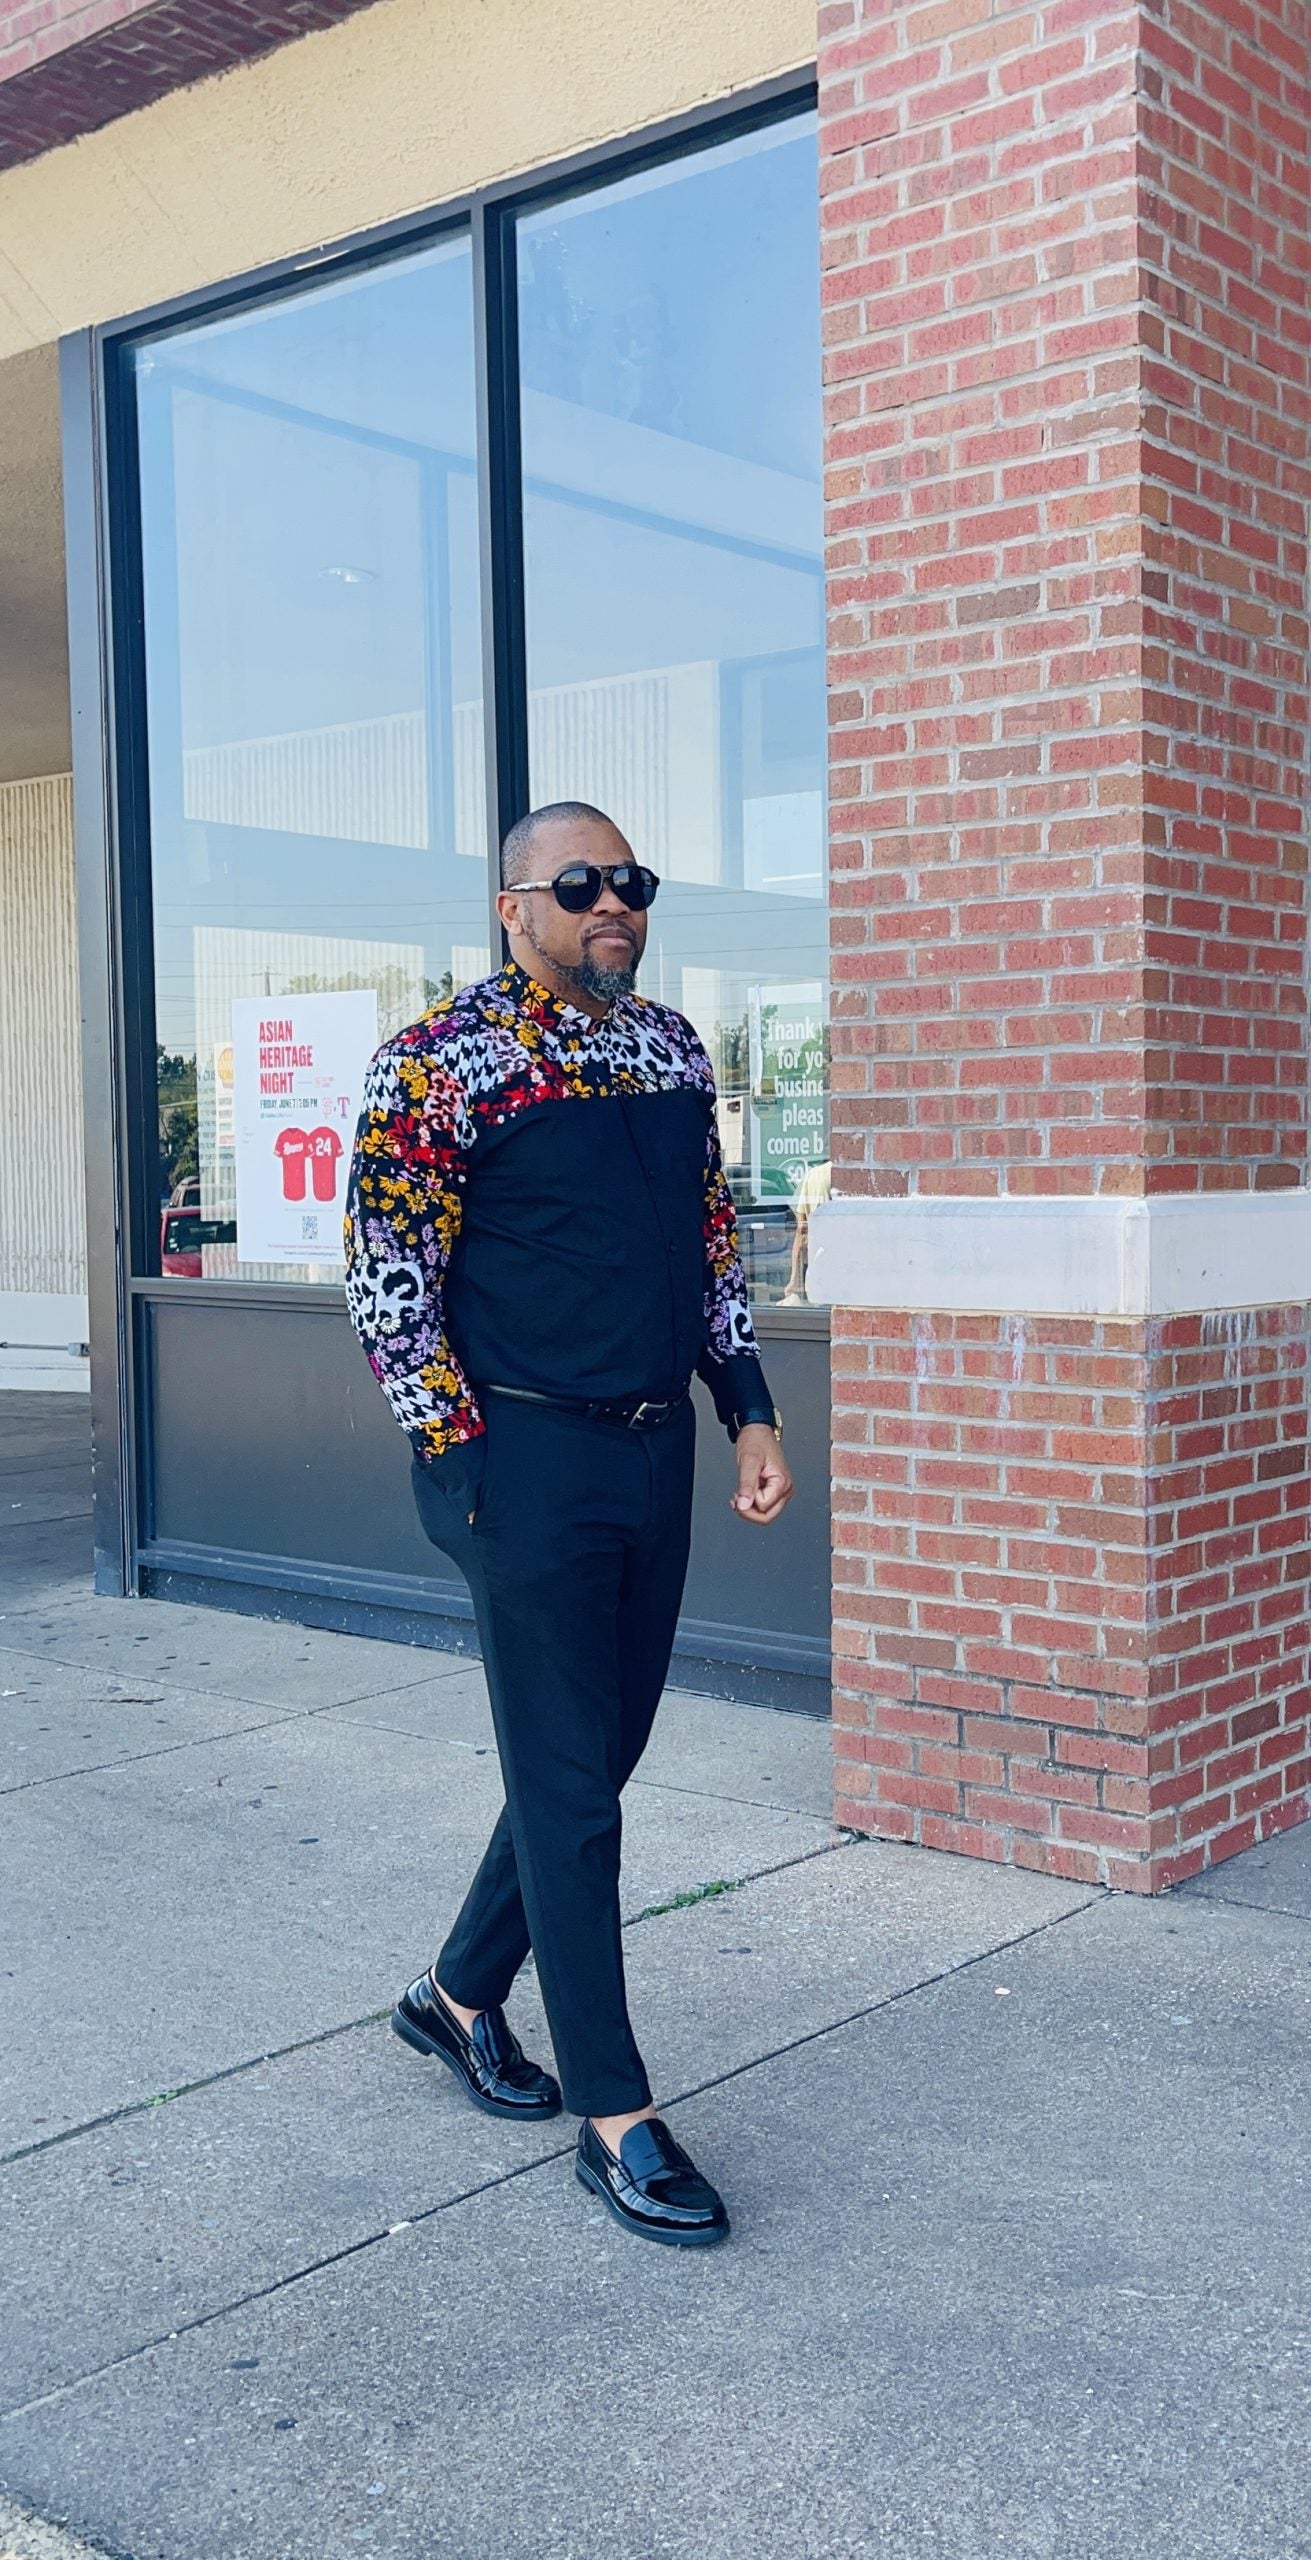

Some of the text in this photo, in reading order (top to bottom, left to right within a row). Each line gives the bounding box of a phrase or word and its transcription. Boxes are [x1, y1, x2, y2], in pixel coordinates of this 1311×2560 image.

[259, 1020, 293, 1043] ASIAN
[765, 1016, 816, 1040] Thank
[259, 1045, 314, 1069] HERITAGE
[777, 1046, 800, 1069] for
[260, 1072, 294, 1095] NIGHT
[310, 1098, 318, 1108] PM
[782, 1102, 824, 1132] pleas
[315, 1136, 332, 1156] 24
[767, 1136, 810, 1155] come
